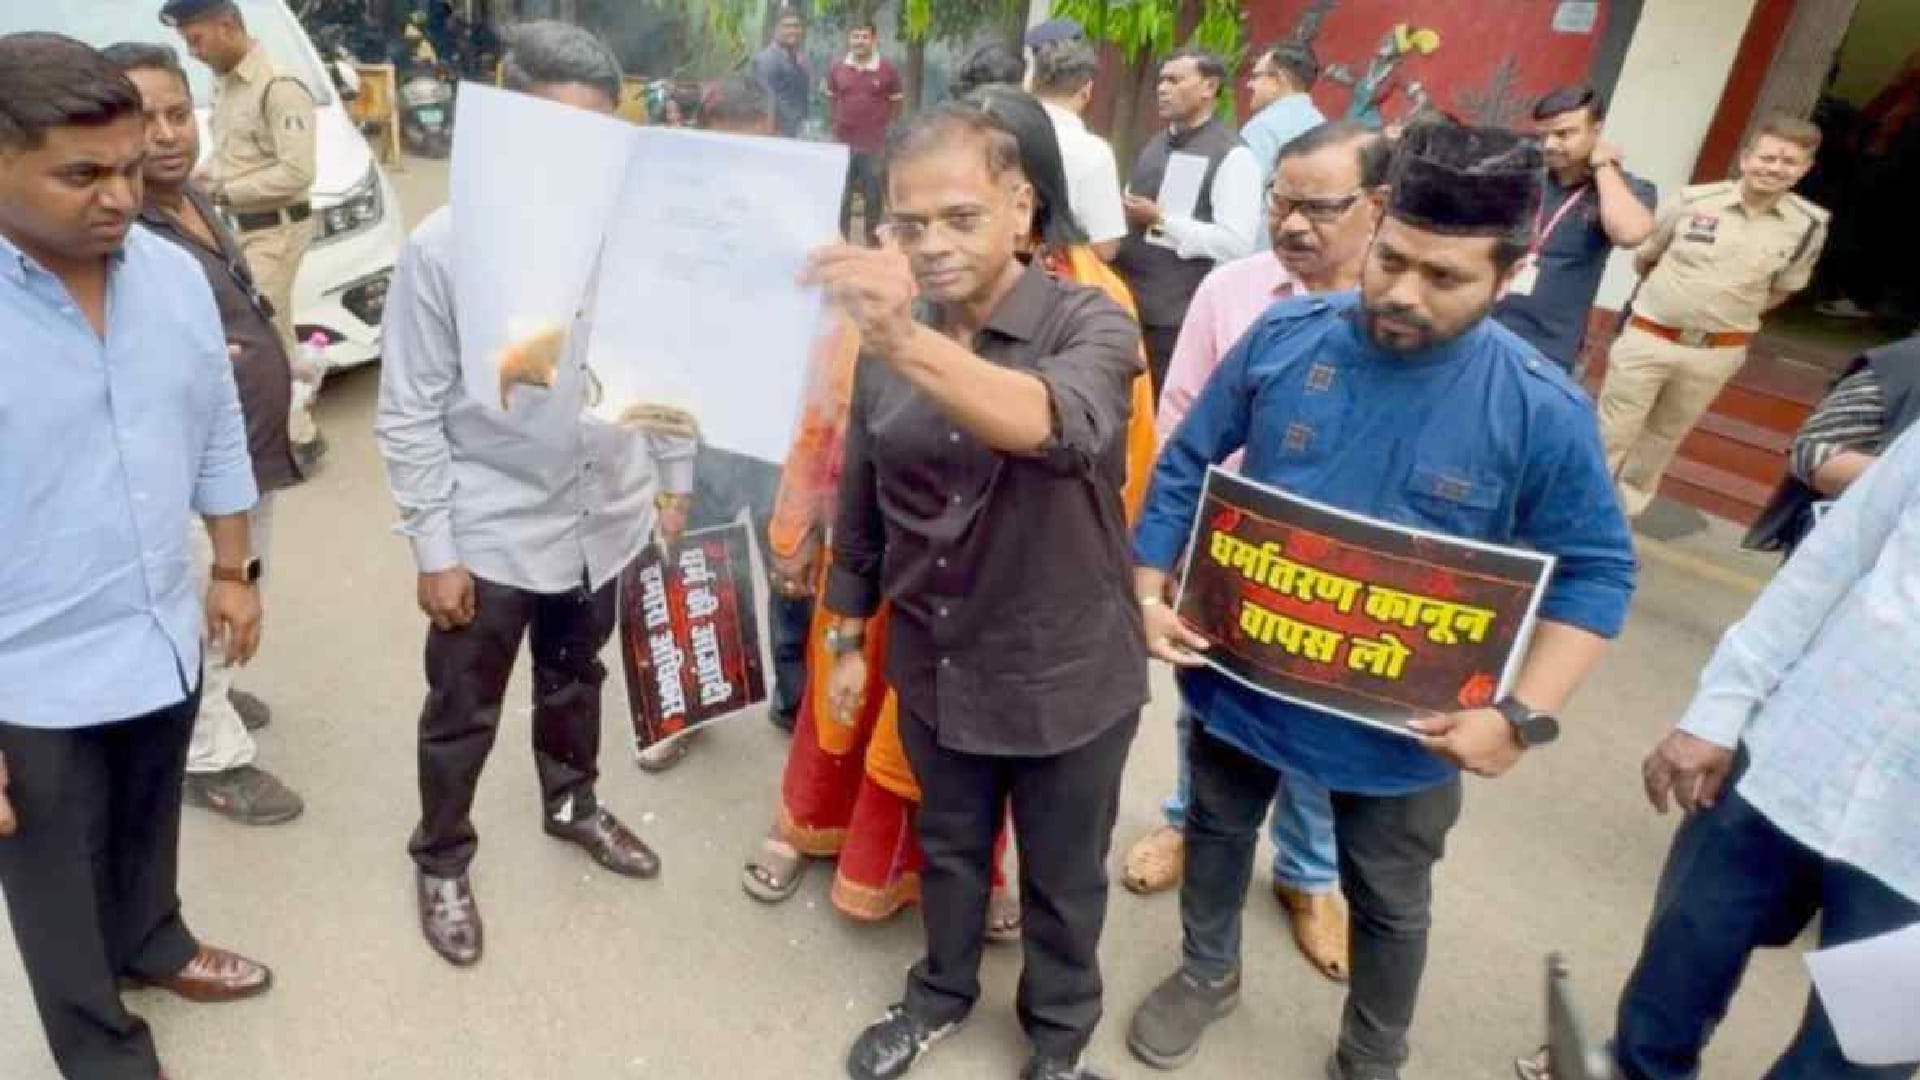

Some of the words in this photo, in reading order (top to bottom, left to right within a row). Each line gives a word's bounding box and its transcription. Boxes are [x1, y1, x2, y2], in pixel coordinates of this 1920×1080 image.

[680, 548, 716, 584] धर्म
[686, 587, 718, 619] की
[1366, 585, 1496, 644] कानून
[1240, 600, 1343, 663] वापस
[1349, 633, 1411, 677] लो
